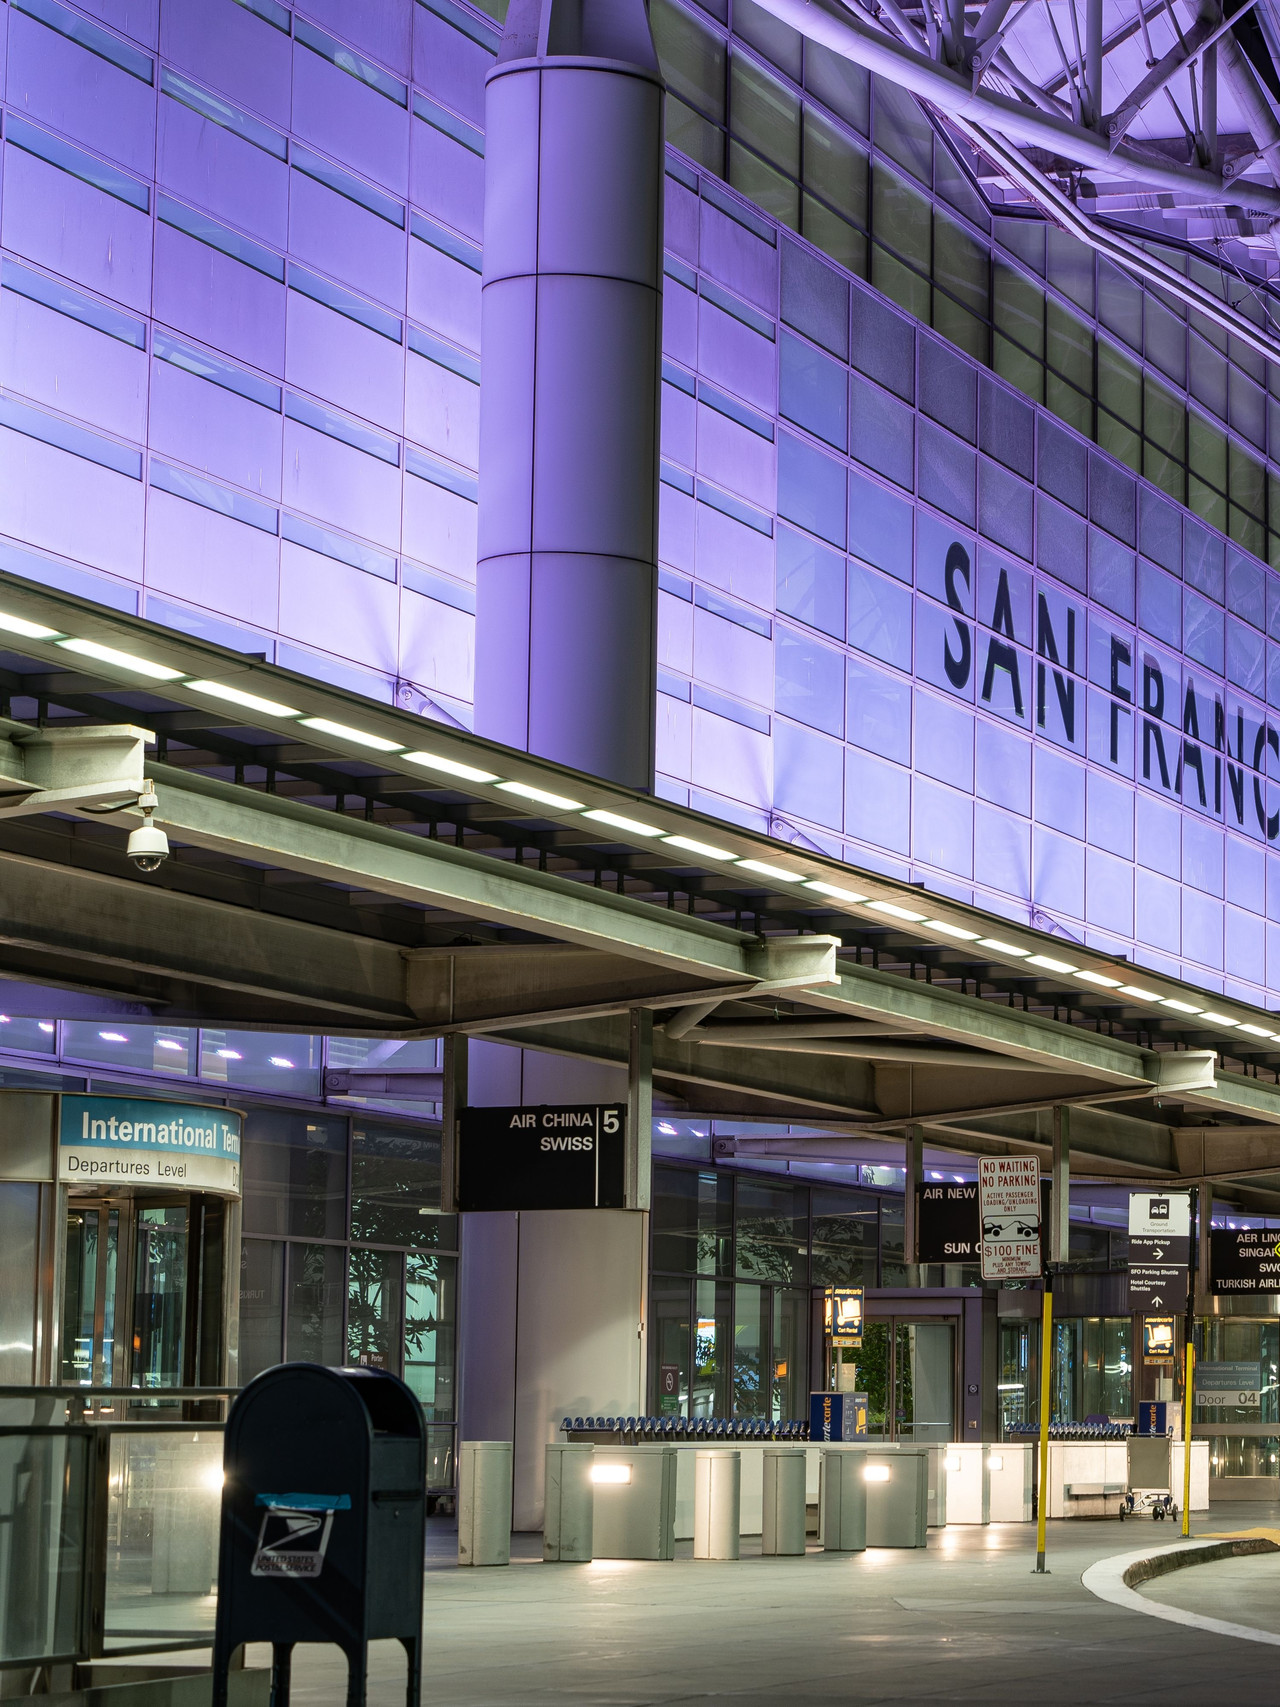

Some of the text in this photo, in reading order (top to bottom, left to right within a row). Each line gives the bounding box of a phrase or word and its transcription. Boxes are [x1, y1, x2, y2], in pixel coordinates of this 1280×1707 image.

[944, 541, 1075, 743] SAN
[509, 1110, 620, 1134] AIR CHINA 5
[82, 1111, 217, 1149] International
[540, 1137, 593, 1151] SWISS
[68, 1156, 187, 1178] Departures Level
[983, 1160, 1035, 1173] NO WAITING
[982, 1174, 1036, 1187] NO PARKING
[923, 1188, 976, 1199] AIR NEW
[983, 1198, 1038, 1206] LOADING/UNLOADING
[1236, 1233, 1258, 1243] AER
[944, 1242, 970, 1254] SUN
[984, 1245, 1012, 1257] $100
[1016, 1244, 1038, 1255] FINE
[1216, 1279, 1256, 1288] TURKISH
[1198, 1392, 1258, 1404] Door 04
[822, 1397, 832, 1442] artecarte
